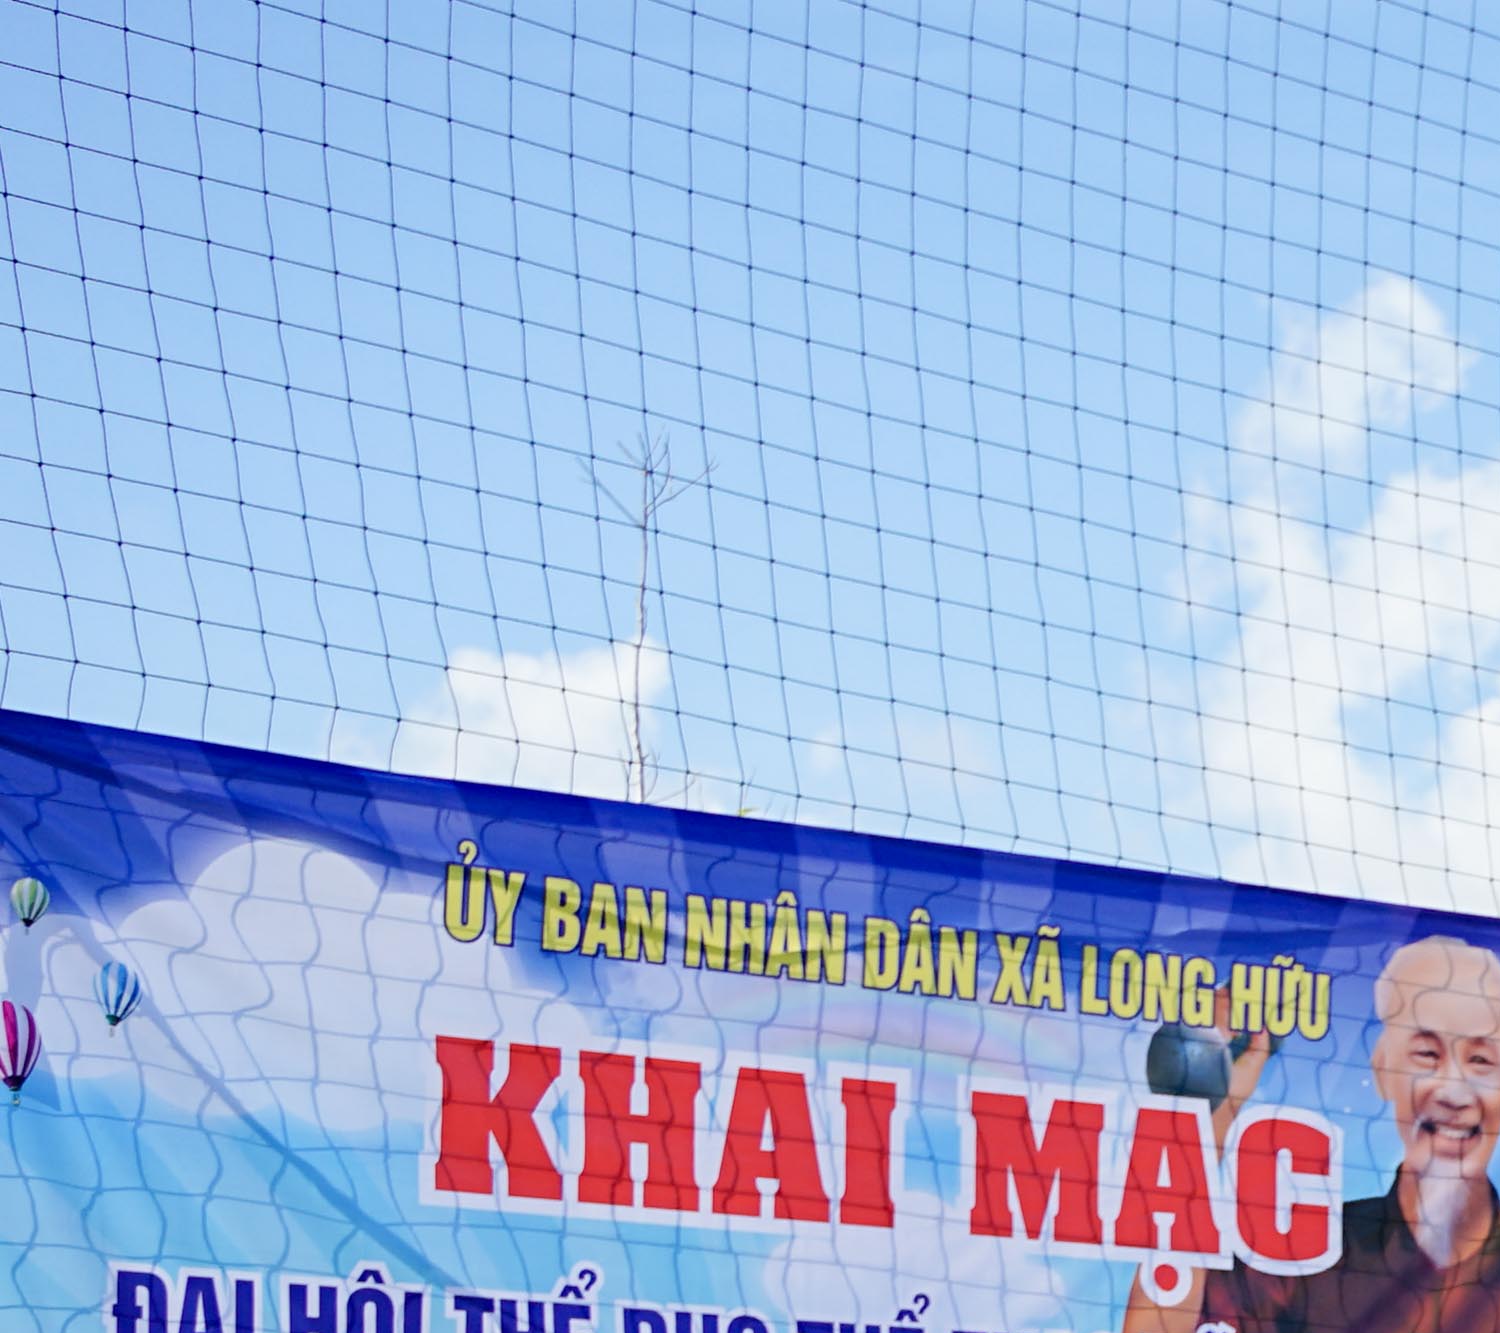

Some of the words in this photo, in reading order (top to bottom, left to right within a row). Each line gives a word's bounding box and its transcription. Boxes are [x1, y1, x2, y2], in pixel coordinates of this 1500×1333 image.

[445, 840, 525, 946] ỦY
[541, 877, 667, 964] BAN
[685, 891, 846, 985] NHÂN
[864, 909, 978, 1002] DÂN
[994, 925, 1062, 1011] XÃ
[1081, 943, 1216, 1029] LONG
[1231, 956, 1332, 1040] HỮU
[436, 1035, 897, 1228] KHAI
[969, 1090, 1337, 1293] MẠC
